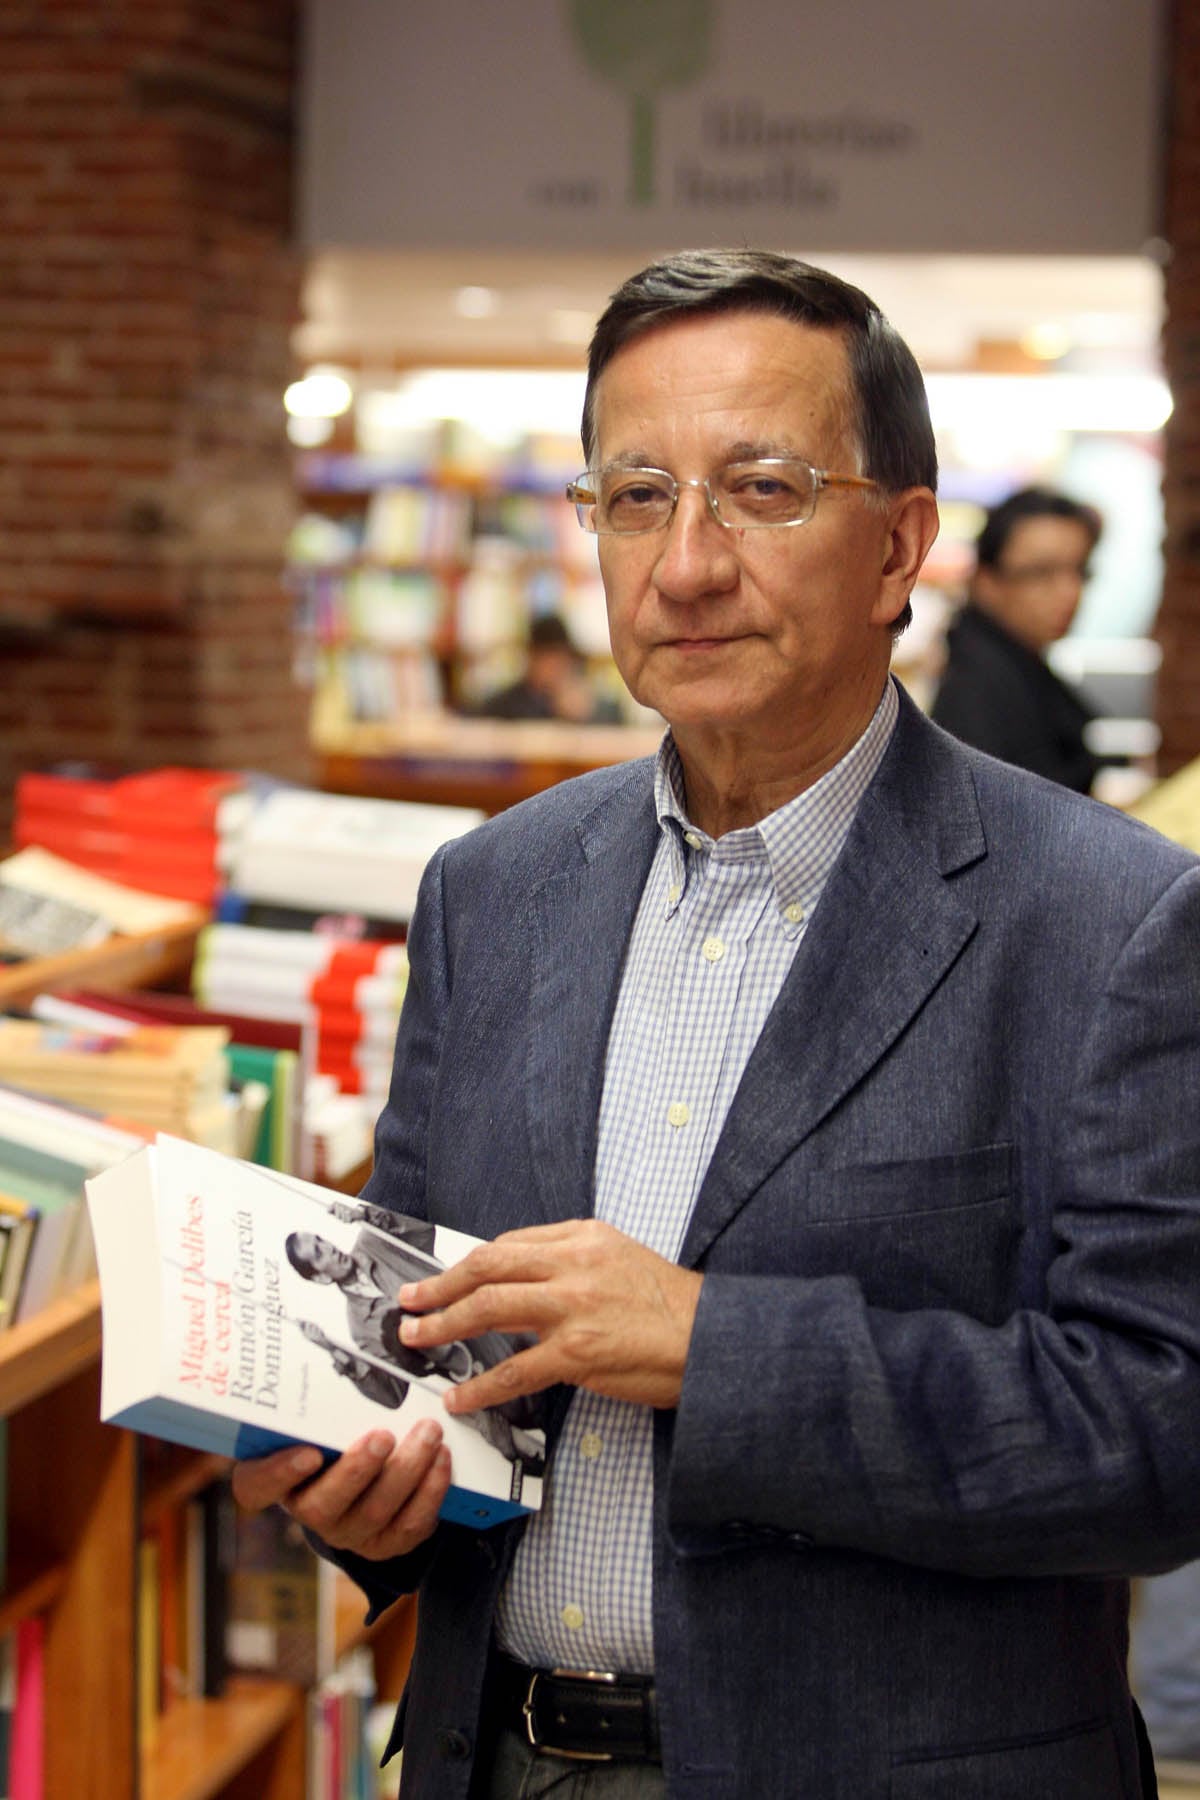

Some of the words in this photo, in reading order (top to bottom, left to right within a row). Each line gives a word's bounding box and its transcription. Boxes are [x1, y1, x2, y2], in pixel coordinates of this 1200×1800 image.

[179, 1194, 206, 1289] Delibes
[231, 1209, 257, 1297] García
[178, 1294, 208, 1389] Miguel
[214, 1280, 232, 1353] cerca
[229, 1303, 257, 1402] Ramón
[256, 1257, 285, 1410] Domínguez
[205, 1361, 230, 1397] de
